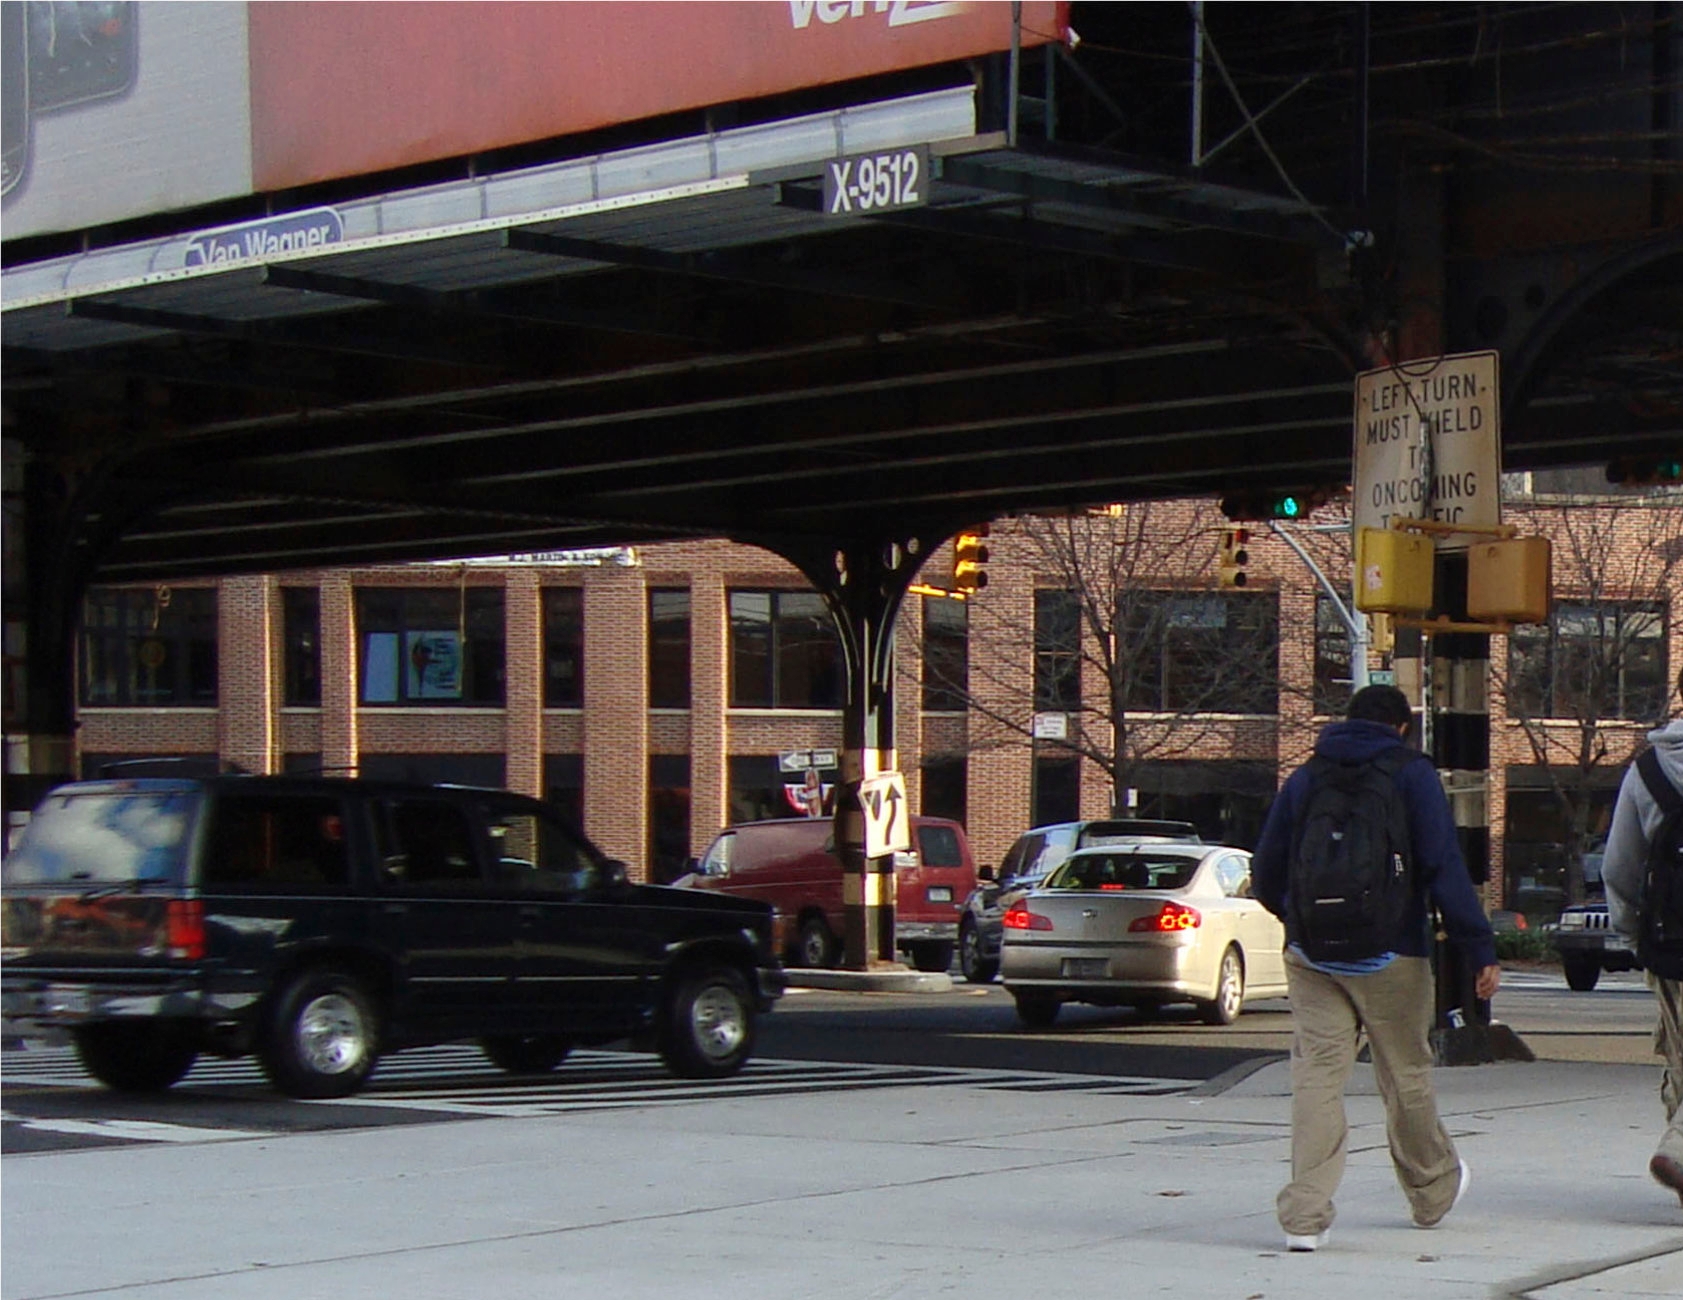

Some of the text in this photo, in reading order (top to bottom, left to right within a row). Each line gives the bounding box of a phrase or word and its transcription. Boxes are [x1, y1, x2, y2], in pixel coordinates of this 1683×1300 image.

[832, 152, 918, 213] X-9512
[201, 225, 331, 264] Van Wagner
[1372, 373, 1476, 412] LEFT TURN
[1367, 414, 1411, 445] MUST
[1381, 506, 1464, 529] TFIC
